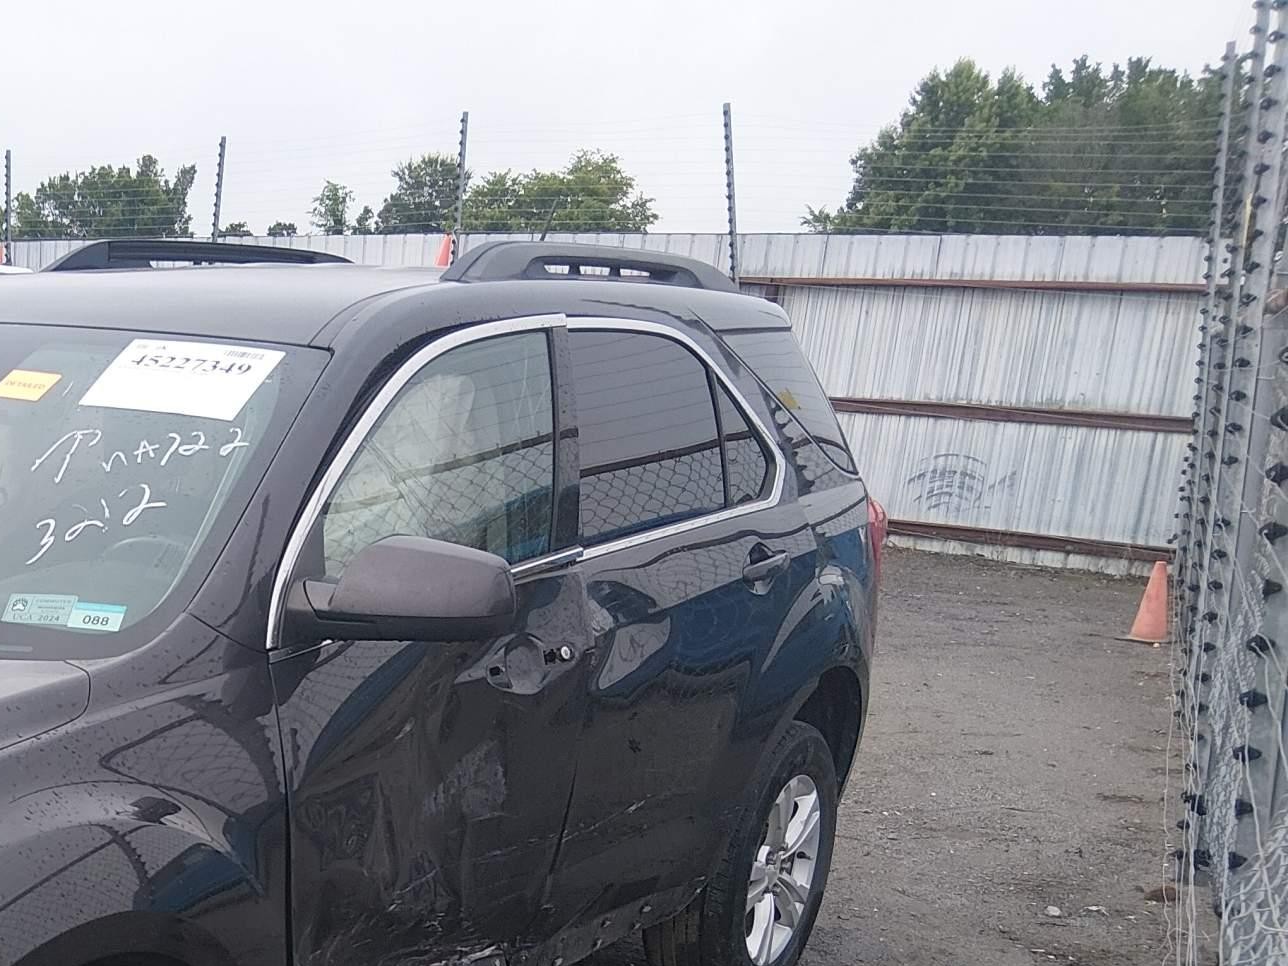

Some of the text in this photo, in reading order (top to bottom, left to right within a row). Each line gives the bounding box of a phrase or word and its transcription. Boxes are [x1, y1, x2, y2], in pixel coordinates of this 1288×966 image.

[130, 353, 253, 376] 45227349
[38, 614, 61, 623] 2024
[82, 614, 110, 626] 088
